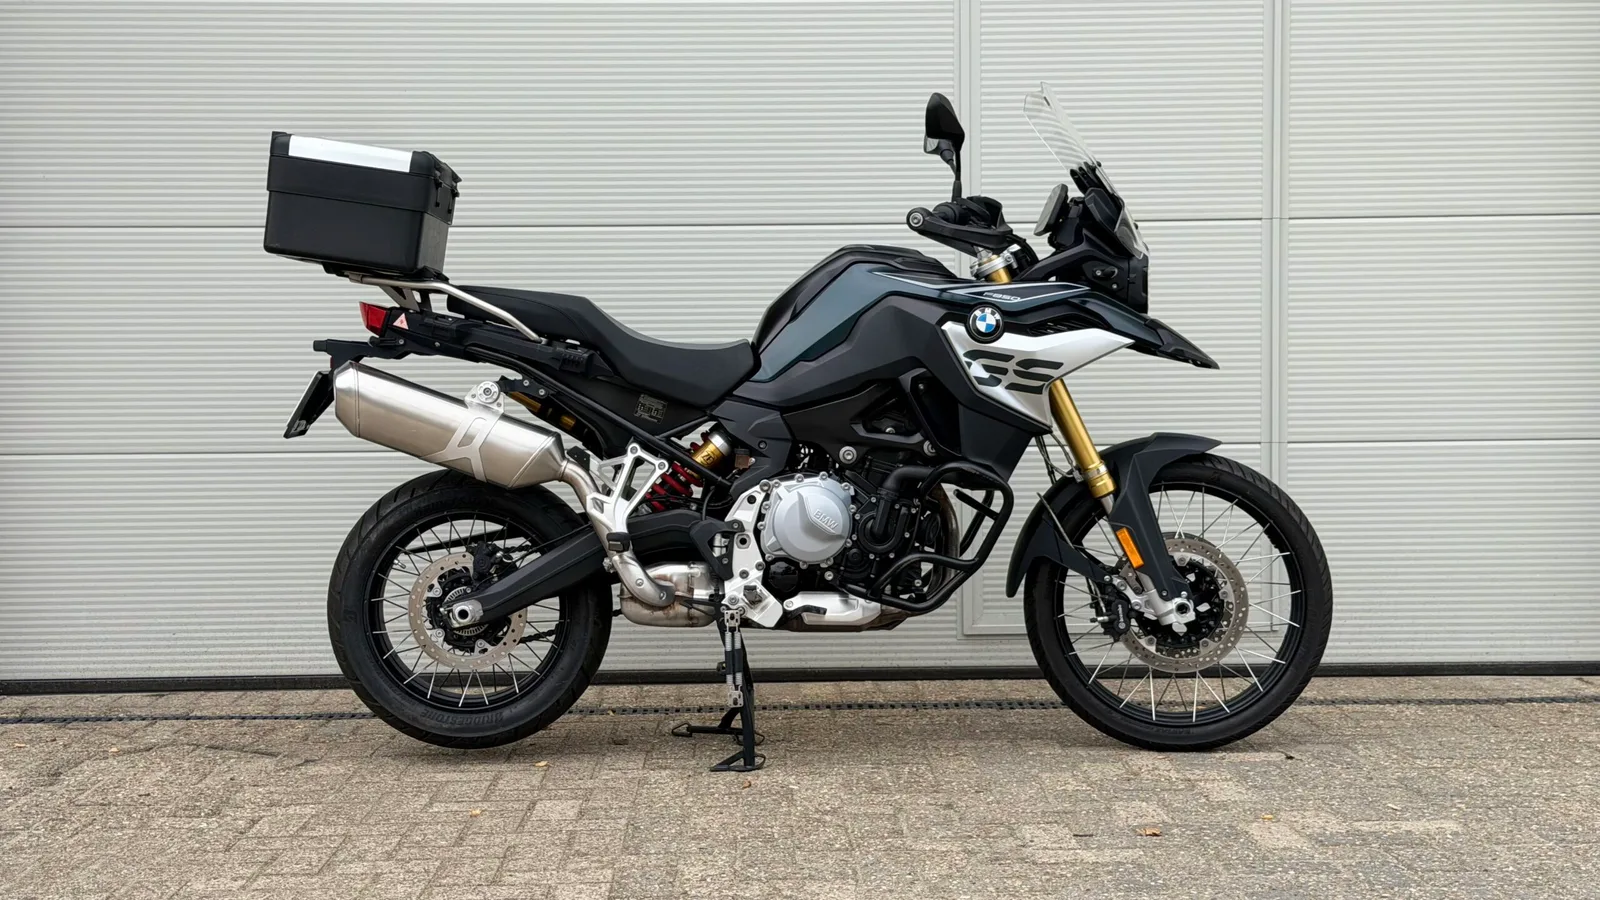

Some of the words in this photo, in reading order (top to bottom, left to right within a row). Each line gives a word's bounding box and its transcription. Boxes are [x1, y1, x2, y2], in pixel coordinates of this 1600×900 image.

[983, 291, 1021, 301] F850
[973, 307, 1001, 320] BMW
[962, 349, 1064, 395] GS
[813, 509, 839, 530] BMW
[420, 708, 505, 726] BRIDGESTONE
